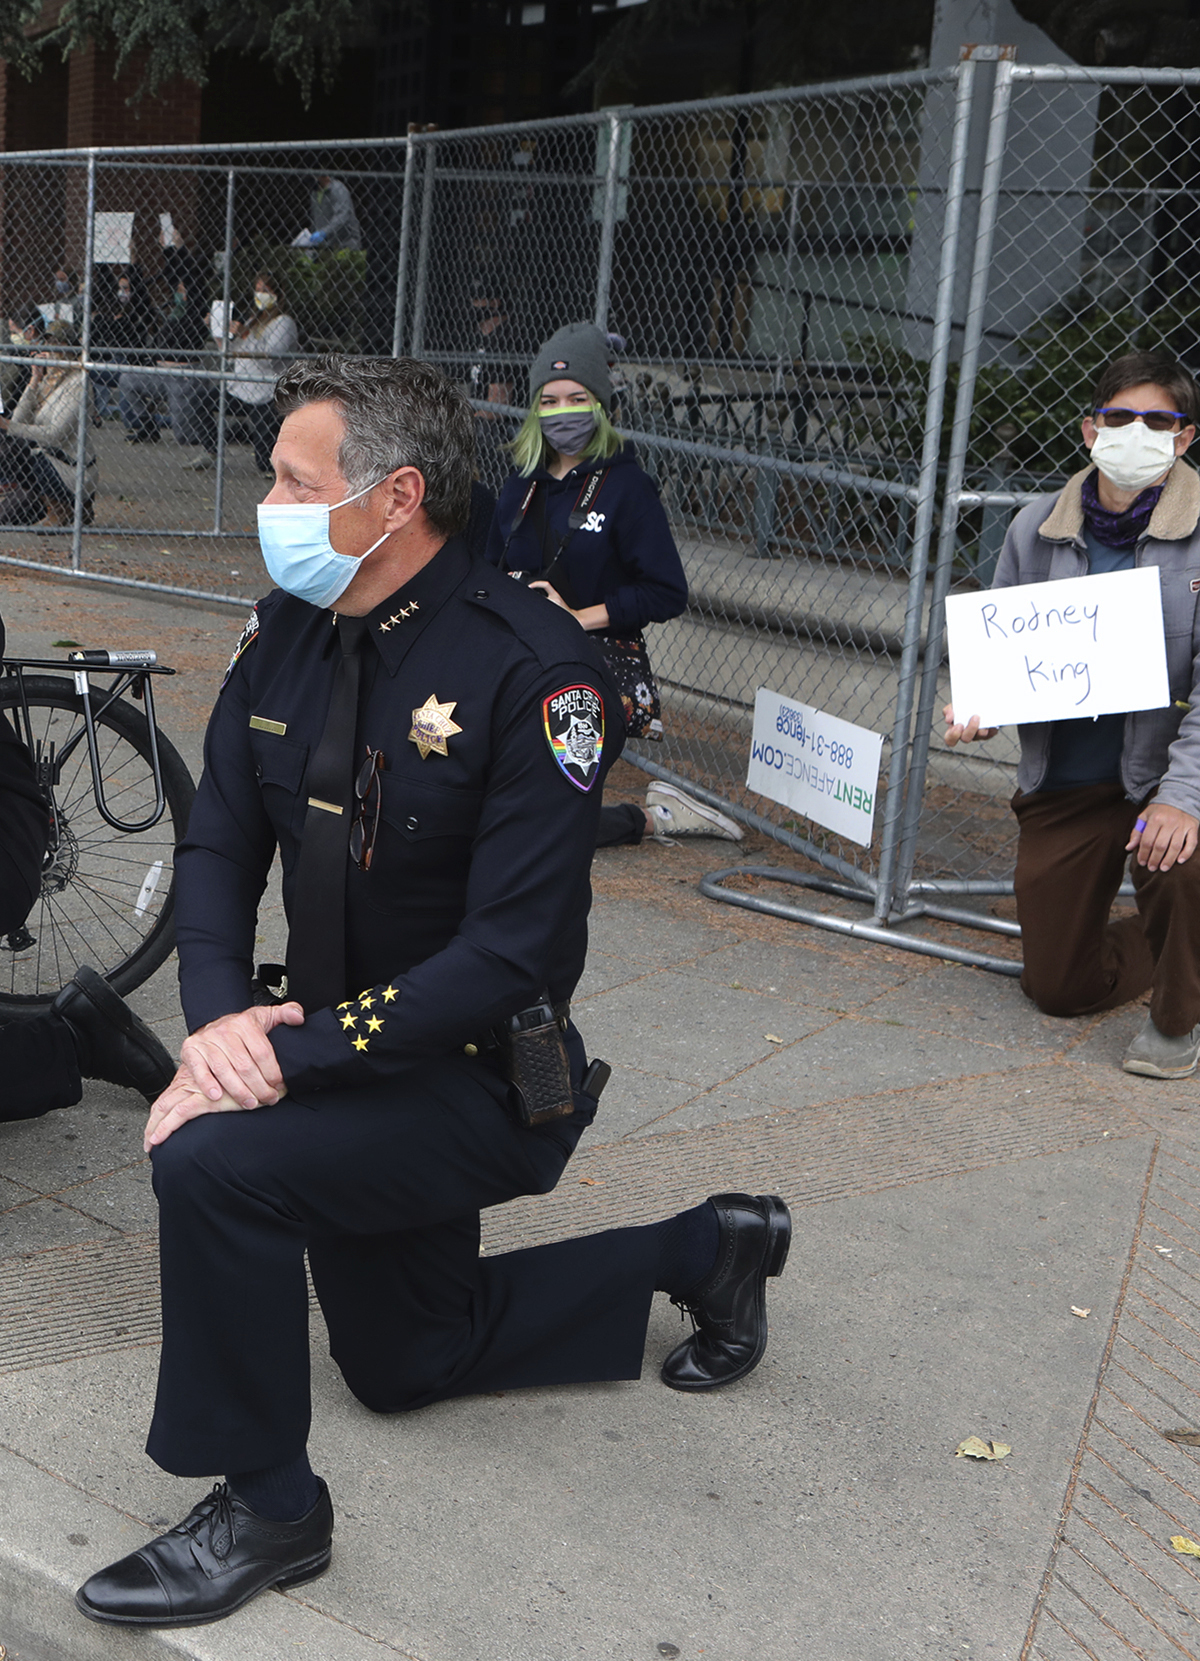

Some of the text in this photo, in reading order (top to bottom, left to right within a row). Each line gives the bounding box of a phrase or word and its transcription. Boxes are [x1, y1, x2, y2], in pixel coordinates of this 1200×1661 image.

[580, 475, 599, 508] DIGITAL
[981, 601, 1099, 642] Rodney
[1024, 655, 1091, 705] King
[551, 689, 582, 713] SANTA
[559, 700, 598, 721] POLICE
[776, 715, 854, 769] 888-31-fence
[752, 740, 873, 815] RENTAFENCE.COM
